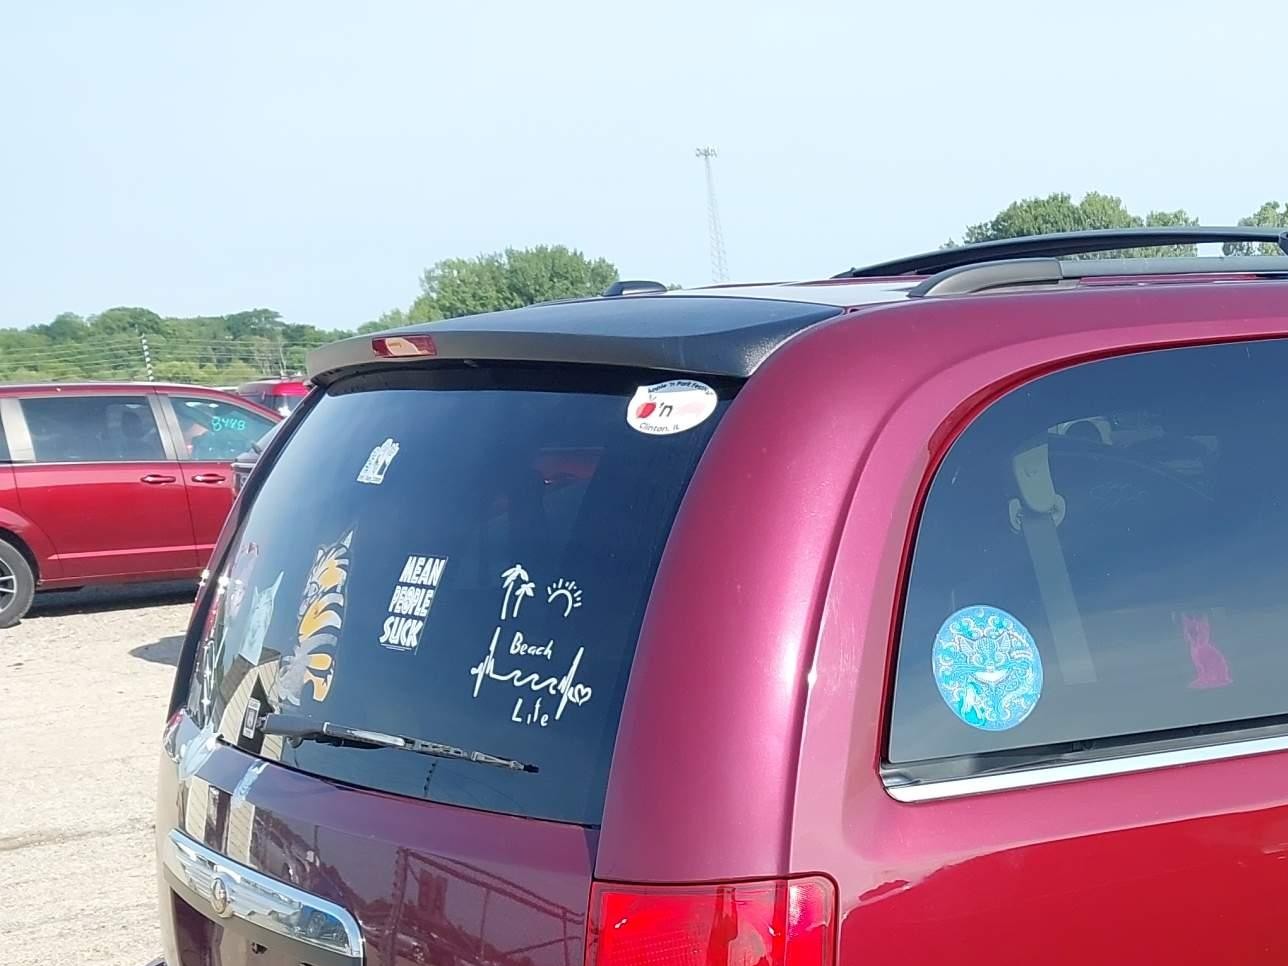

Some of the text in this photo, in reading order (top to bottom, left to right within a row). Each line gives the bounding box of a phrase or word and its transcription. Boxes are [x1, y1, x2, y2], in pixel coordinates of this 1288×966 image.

[398, 556, 446, 587] MEAN
[388, 585, 435, 617] PEOPLE
[379, 615, 424, 648] SUCK
[509, 631, 554, 660] Beach
[511, 697, 549, 727] Life
